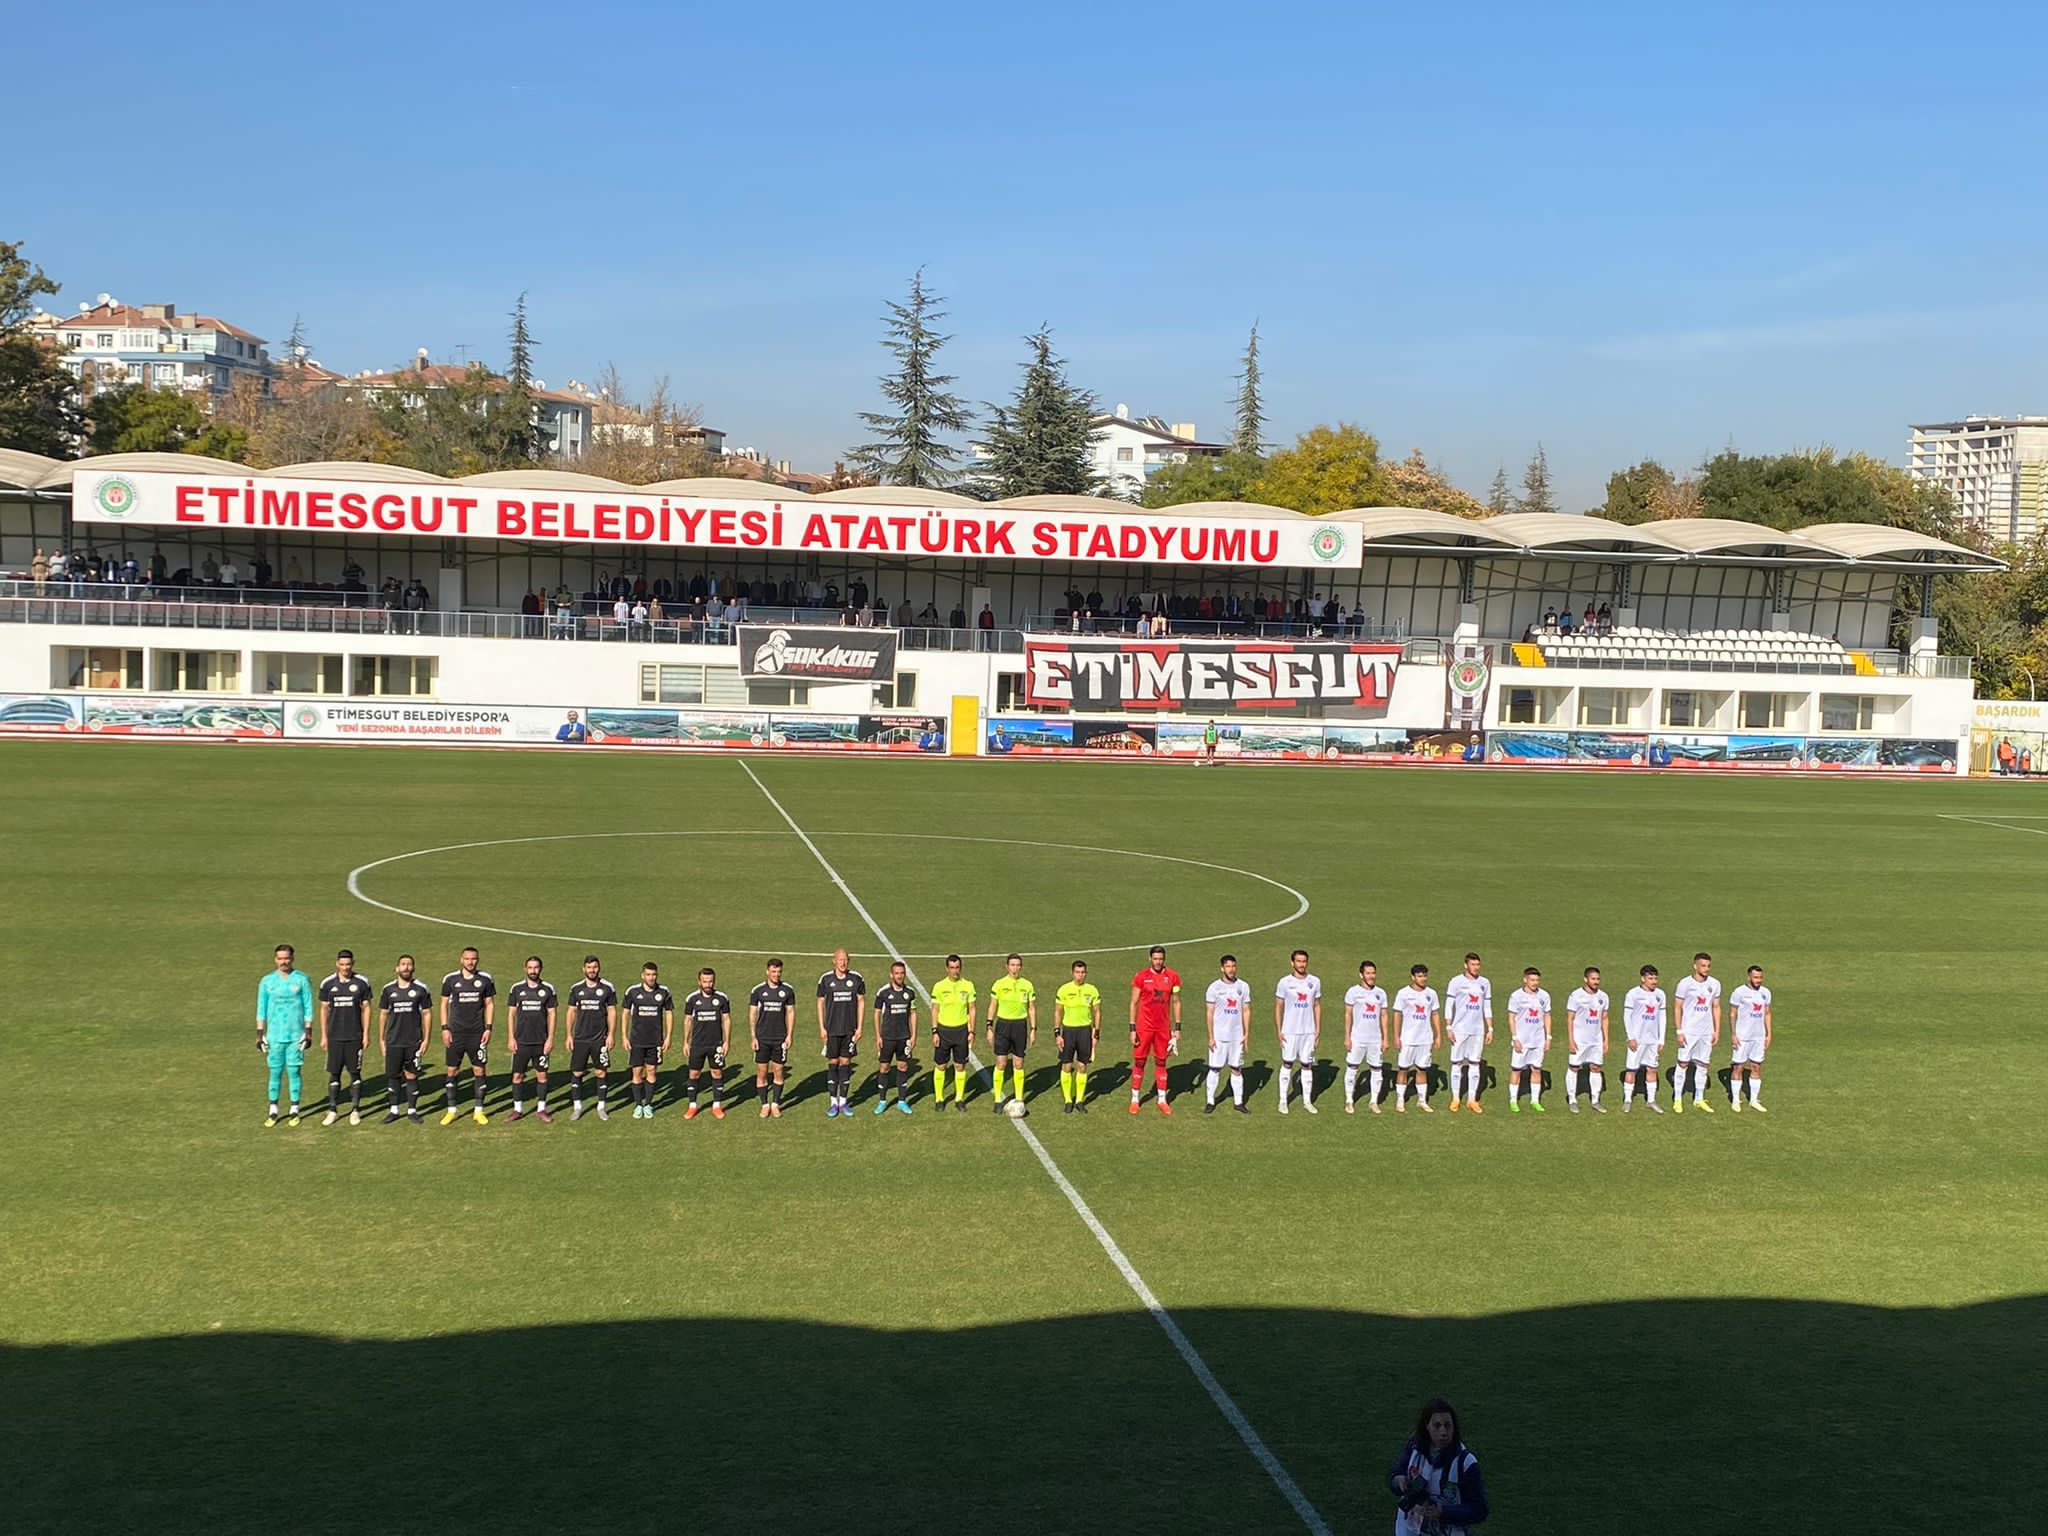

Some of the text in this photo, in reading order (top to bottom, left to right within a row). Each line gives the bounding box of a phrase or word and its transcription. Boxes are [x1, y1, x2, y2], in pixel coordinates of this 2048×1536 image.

[175, 479, 478, 534] ETİMESGUT
[497, 499, 783, 547] BELEDİYESİ
[800, 509, 1016, 555] ATATÜRK
[1032, 521, 1279, 564] STADYUMU
[1029, 649, 1401, 700] ETİMESGUT
[327, 706, 510, 723] ETİMESGUT BELEDİYESPOR'A
[336, 723, 502, 736] YENİ SEZONDA BAŞARILAR DİLERİM
